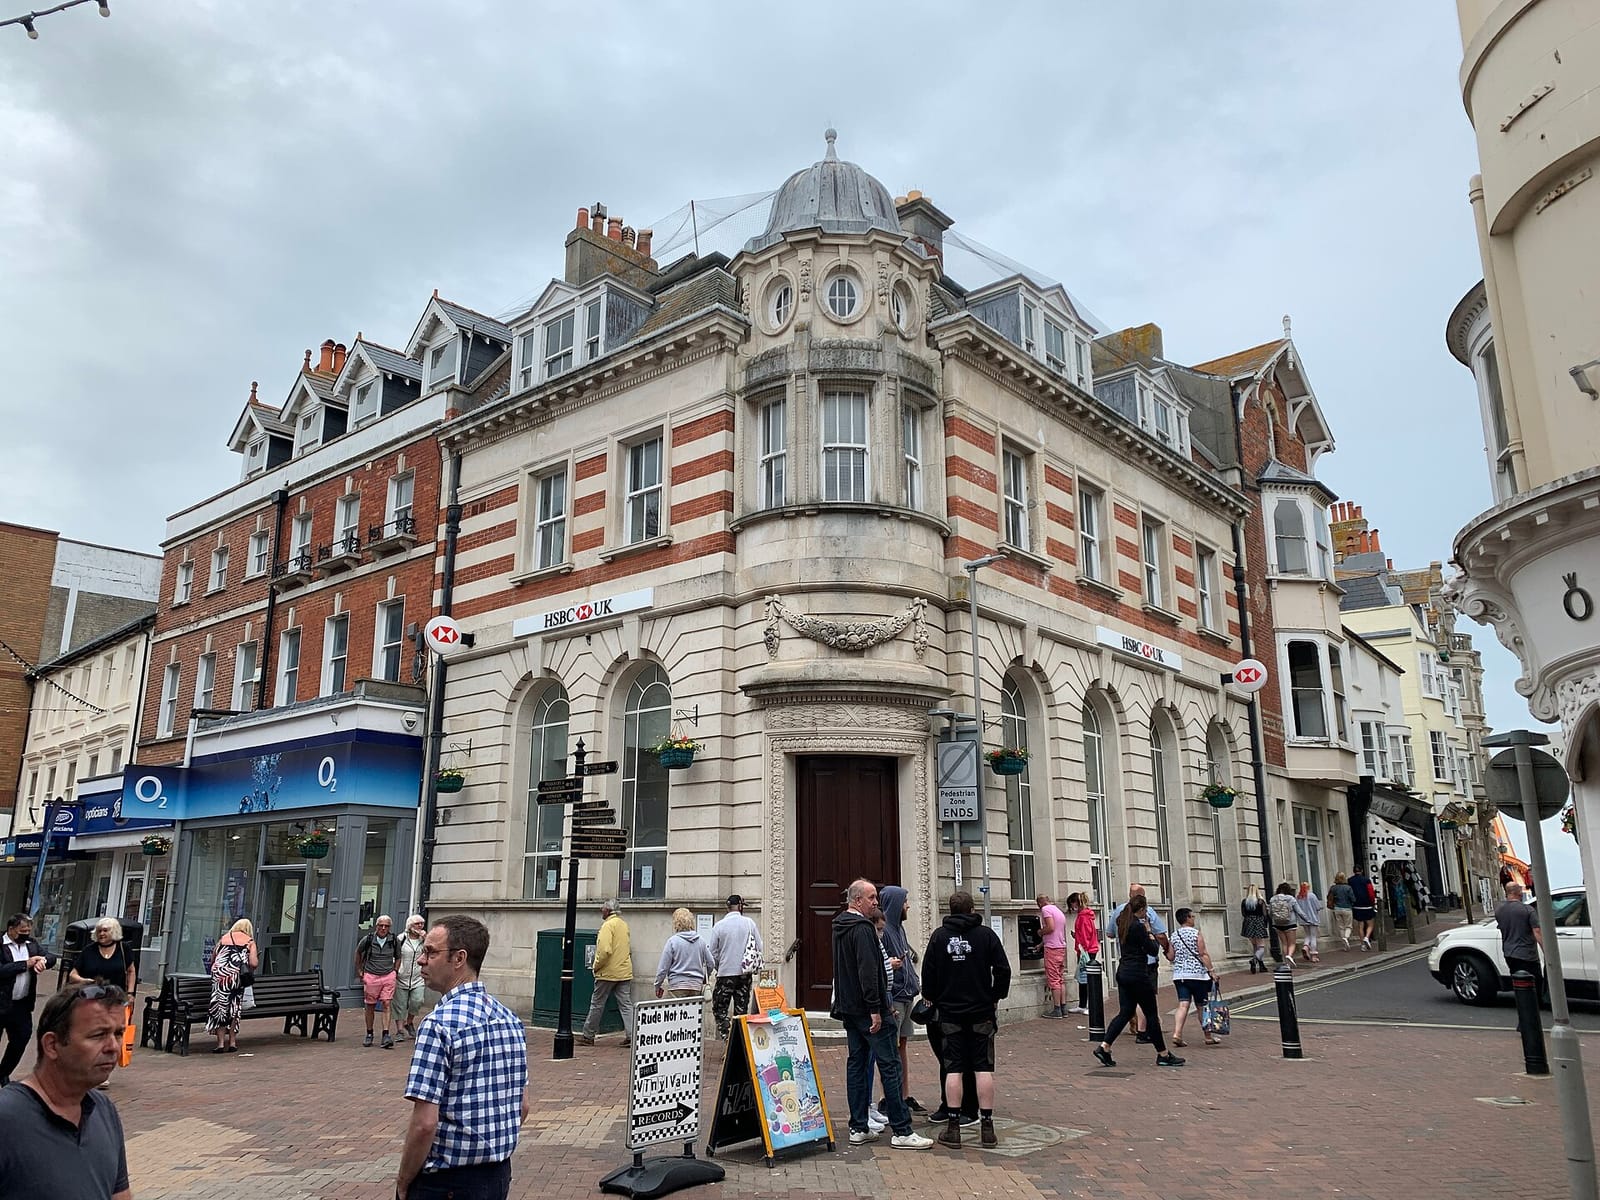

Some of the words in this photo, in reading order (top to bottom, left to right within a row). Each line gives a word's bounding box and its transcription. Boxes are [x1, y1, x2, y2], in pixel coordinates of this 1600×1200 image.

[544, 607, 575, 628] HSBC
[594, 598, 613, 616] UK
[1121, 636, 1143, 655] HSBC
[1152, 648, 1164, 663] UK
[940, 789, 976, 798] Pedestrian
[949, 797, 966, 806] Zone
[85, 806, 109, 821] opticians
[943, 807, 974, 818] ENDS
[1369, 836, 1405, 847] rude
[641, 1010, 662, 1025] Rude
[664, 1010, 677, 1022] Not
[680, 1009, 695, 1021] to...
[639, 1033, 663, 1047] Retro
[665, 1027, 697, 1044] Clothing
[638, 1109, 685, 1126] RECORDS
